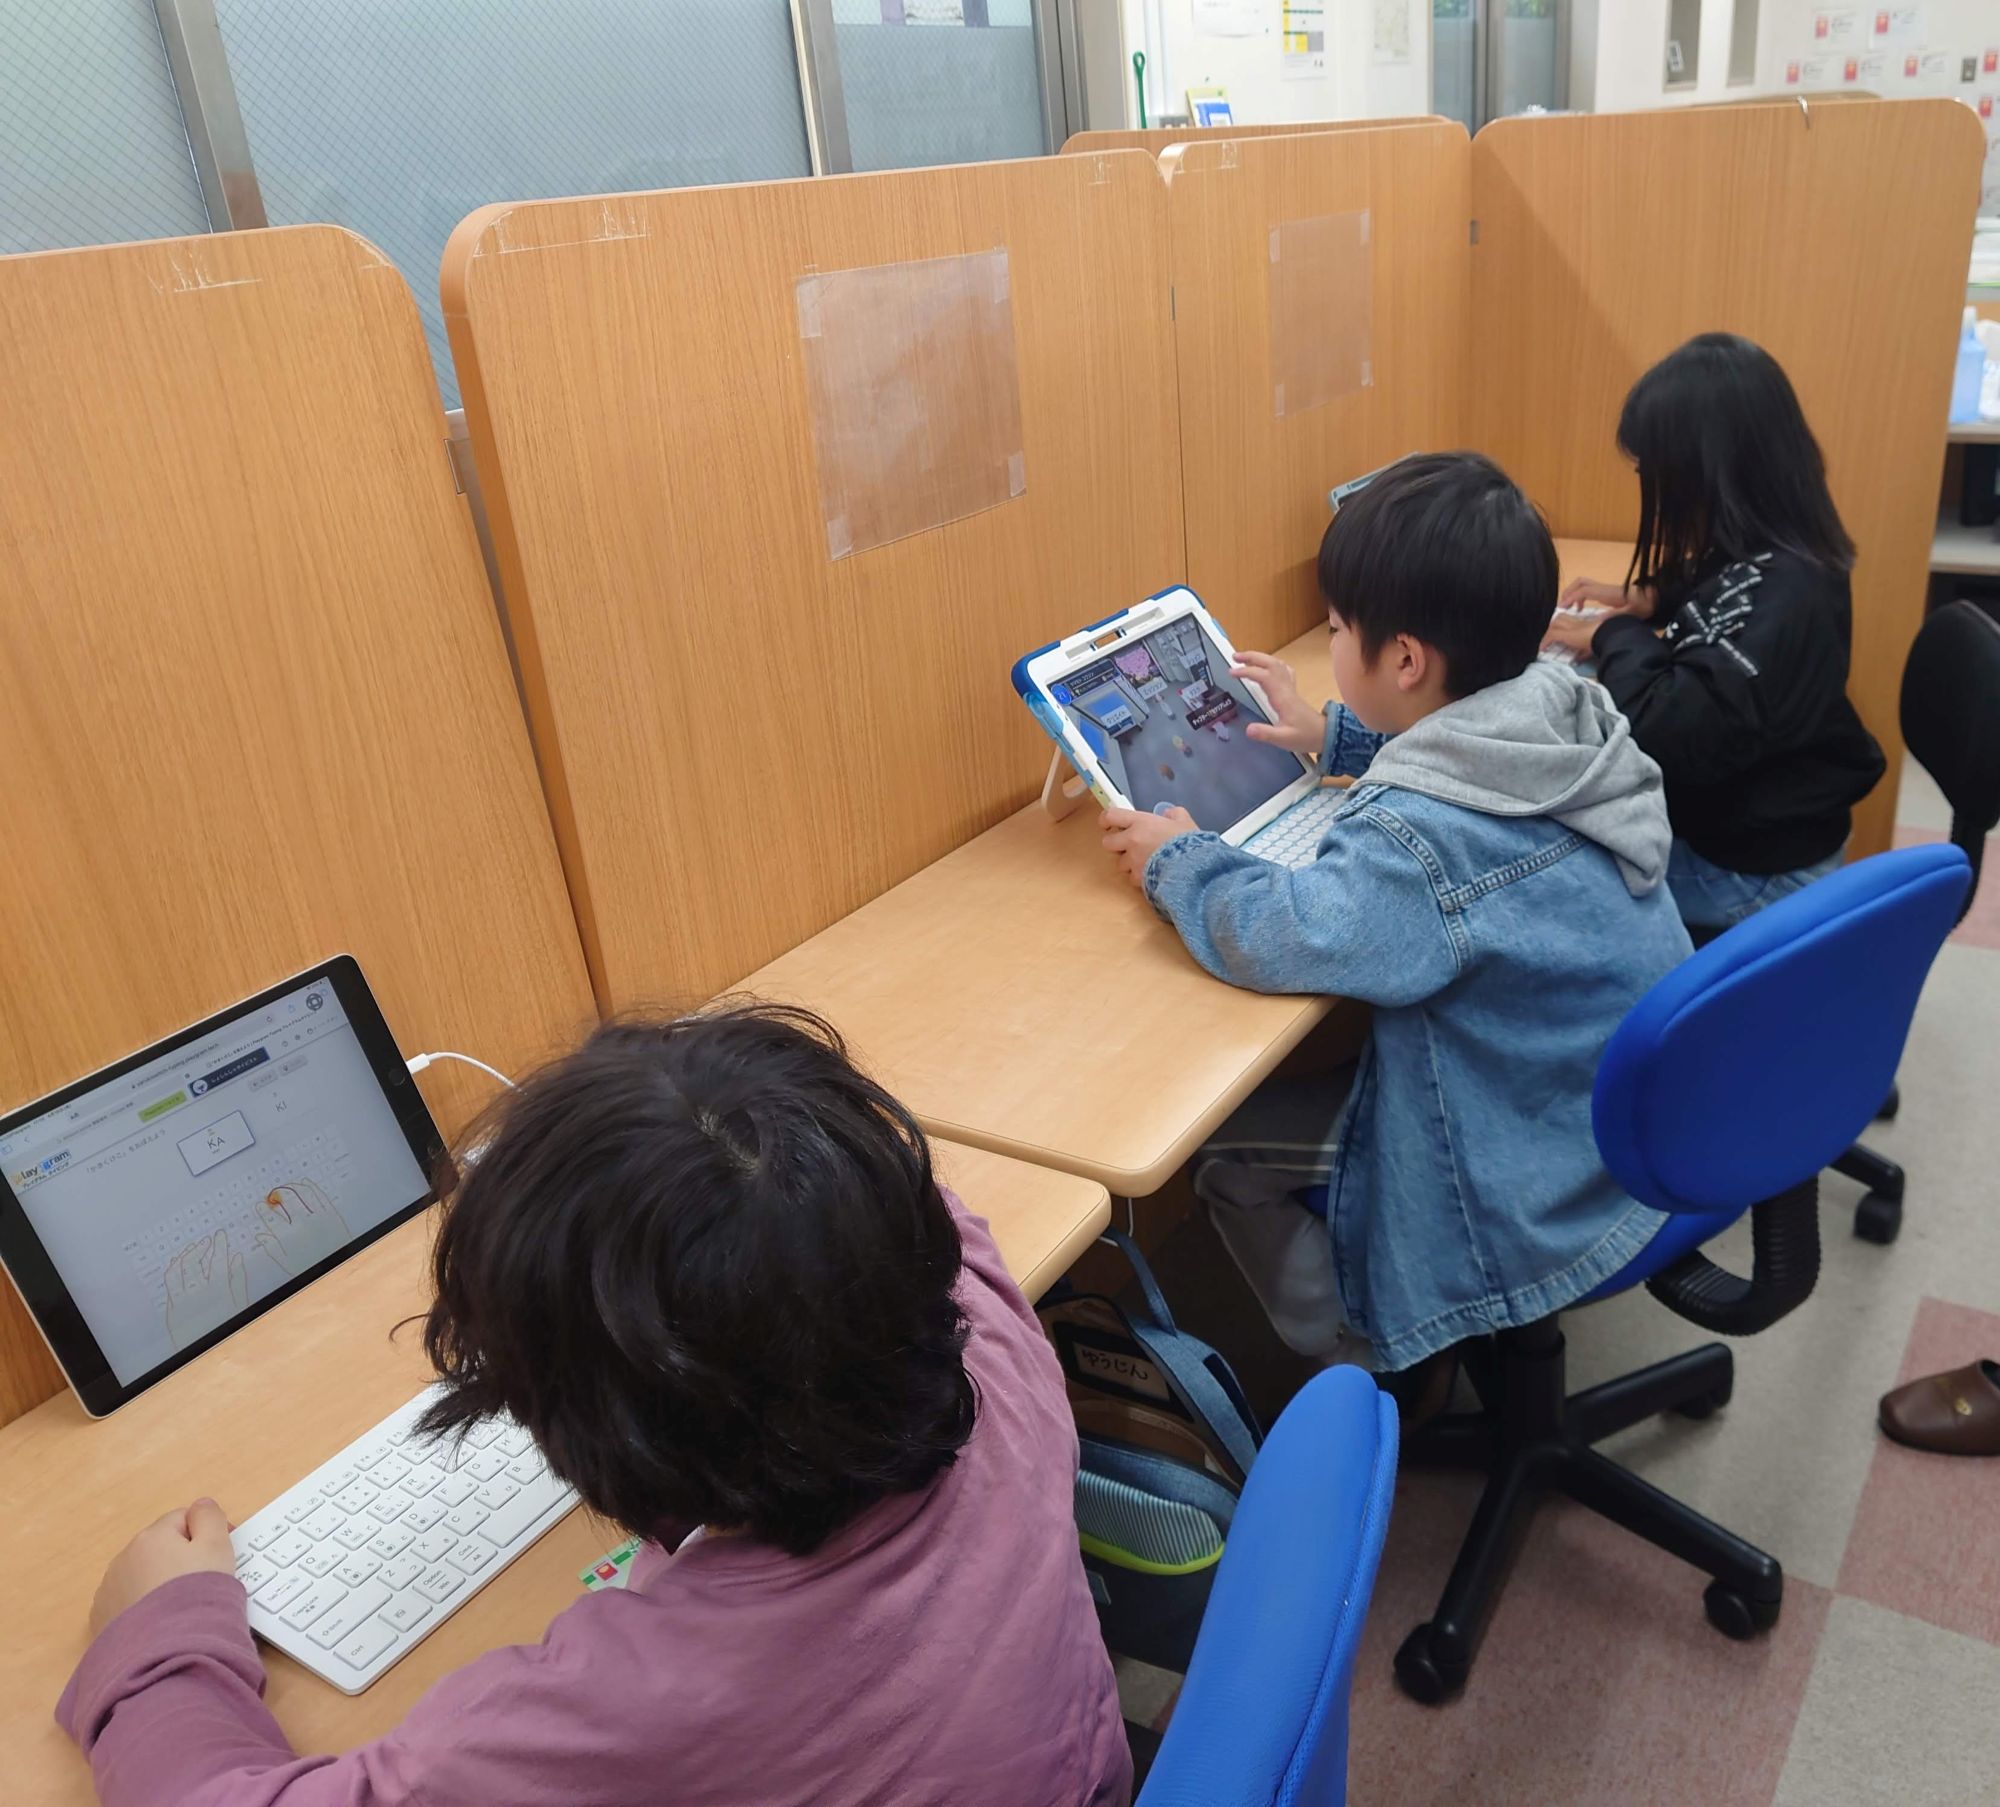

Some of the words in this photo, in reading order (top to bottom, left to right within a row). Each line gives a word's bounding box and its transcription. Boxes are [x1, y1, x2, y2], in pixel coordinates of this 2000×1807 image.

[207, 1137, 226, 1150] KA
[1081, 1351, 1149, 1381] ゆうじん
[422, 1569, 443, 1586] Option
[350, 1644, 365, 1657] Ctrl
